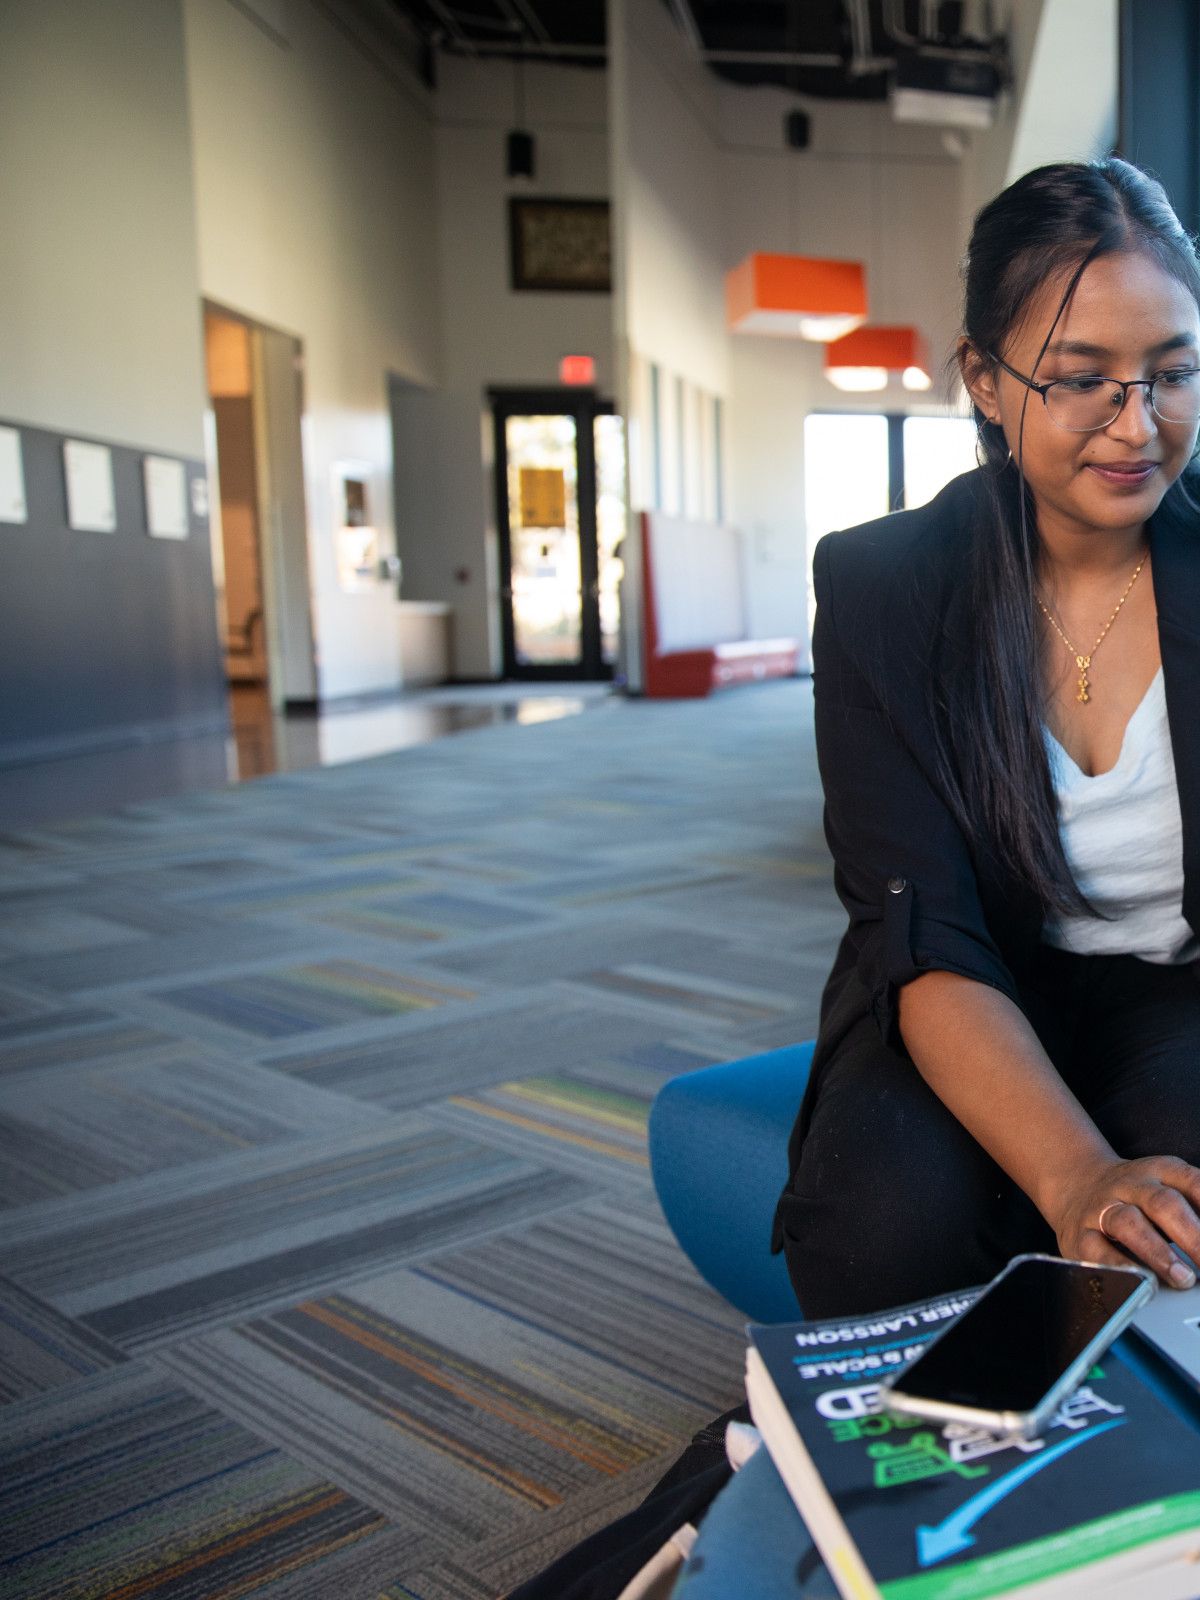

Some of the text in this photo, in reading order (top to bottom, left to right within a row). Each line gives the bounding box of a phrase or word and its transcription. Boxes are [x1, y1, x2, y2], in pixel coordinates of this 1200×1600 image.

[922, 1299, 972, 1323] NER
[795, 1315, 918, 1347] LARSSON
[799, 1354, 883, 1380] SCALE
[815, 1382, 886, 1421] ED
